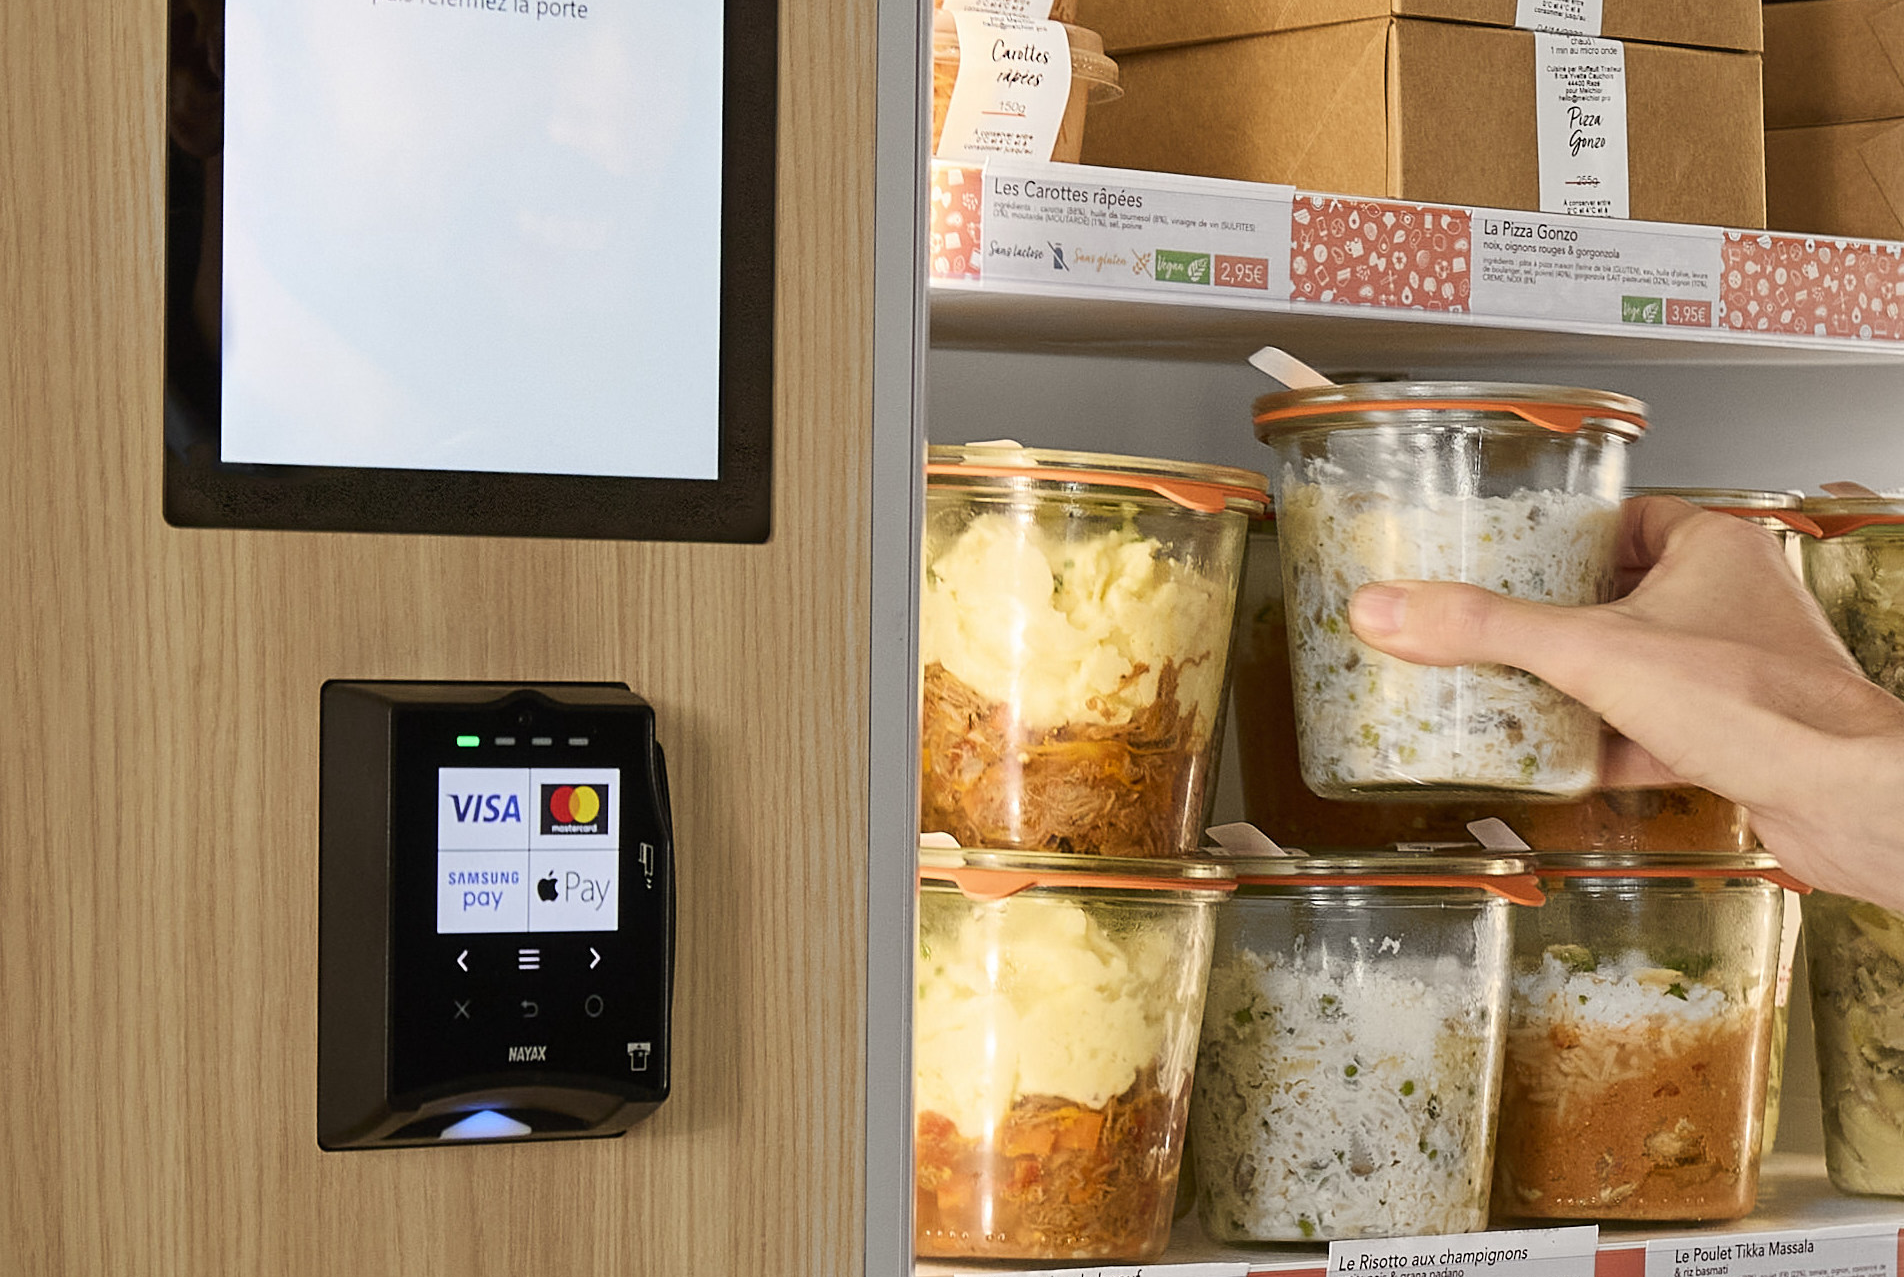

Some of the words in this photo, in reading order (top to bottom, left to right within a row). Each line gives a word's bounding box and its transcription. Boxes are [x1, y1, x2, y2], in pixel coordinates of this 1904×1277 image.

[992, 39, 1050, 65] Carottes
[1567, 106, 1603, 131] Pizza
[1569, 129, 1606, 157] Gonzo
[994, 177, 1019, 199] Les
[1024, 181, 1088, 204] Carottes
[1093, 188, 1142, 209] râpées
[1484, 220, 1498, 236] La
[1503, 222, 1533, 238] Pizza
[1537, 224, 1578, 241] Gonzo
[989, 241, 1012, 257] Sans
[1013, 242, 1044, 261] lactose
[1073, 248, 1095, 264] Sans
[1483, 241, 1502, 251] noix,
[1505, 242, 1536, 254] oignons
[1538, 245, 1566, 257] rouges
[1568, 245, 1574, 255] &
[1576, 249, 1620, 259] gorgonzola
[1220, 263, 1264, 284] 2,95€
[1672, 305, 1706, 323] 3,95€
[447, 794, 521, 823] VISA
[551, 824, 598, 833] mastercard
[448, 871, 519, 886] SAMSUNG
[463, 890, 503, 911] pay
[565, 871, 610, 911] Pay
[509, 1045, 547, 1062] NAYAX
[1339, 1256, 1355, 1272] Le
[1359, 1253, 1408, 1270] Risotto
[1412, 1253, 1435, 1267] aux
[1439, 1247, 1528, 1266] champignons
[1675, 1249, 1689, 1264] Le
[1694, 1246, 1732, 1263] Poulet
[1736, 1244, 1765, 1259] Tikka
[1769, 1239, 1814, 1256] Massala
[1674, 1267, 1681, 1277] &
[1684, 1267, 1693, 1277] riz
[1696, 1264, 1728, 1277] basmati
